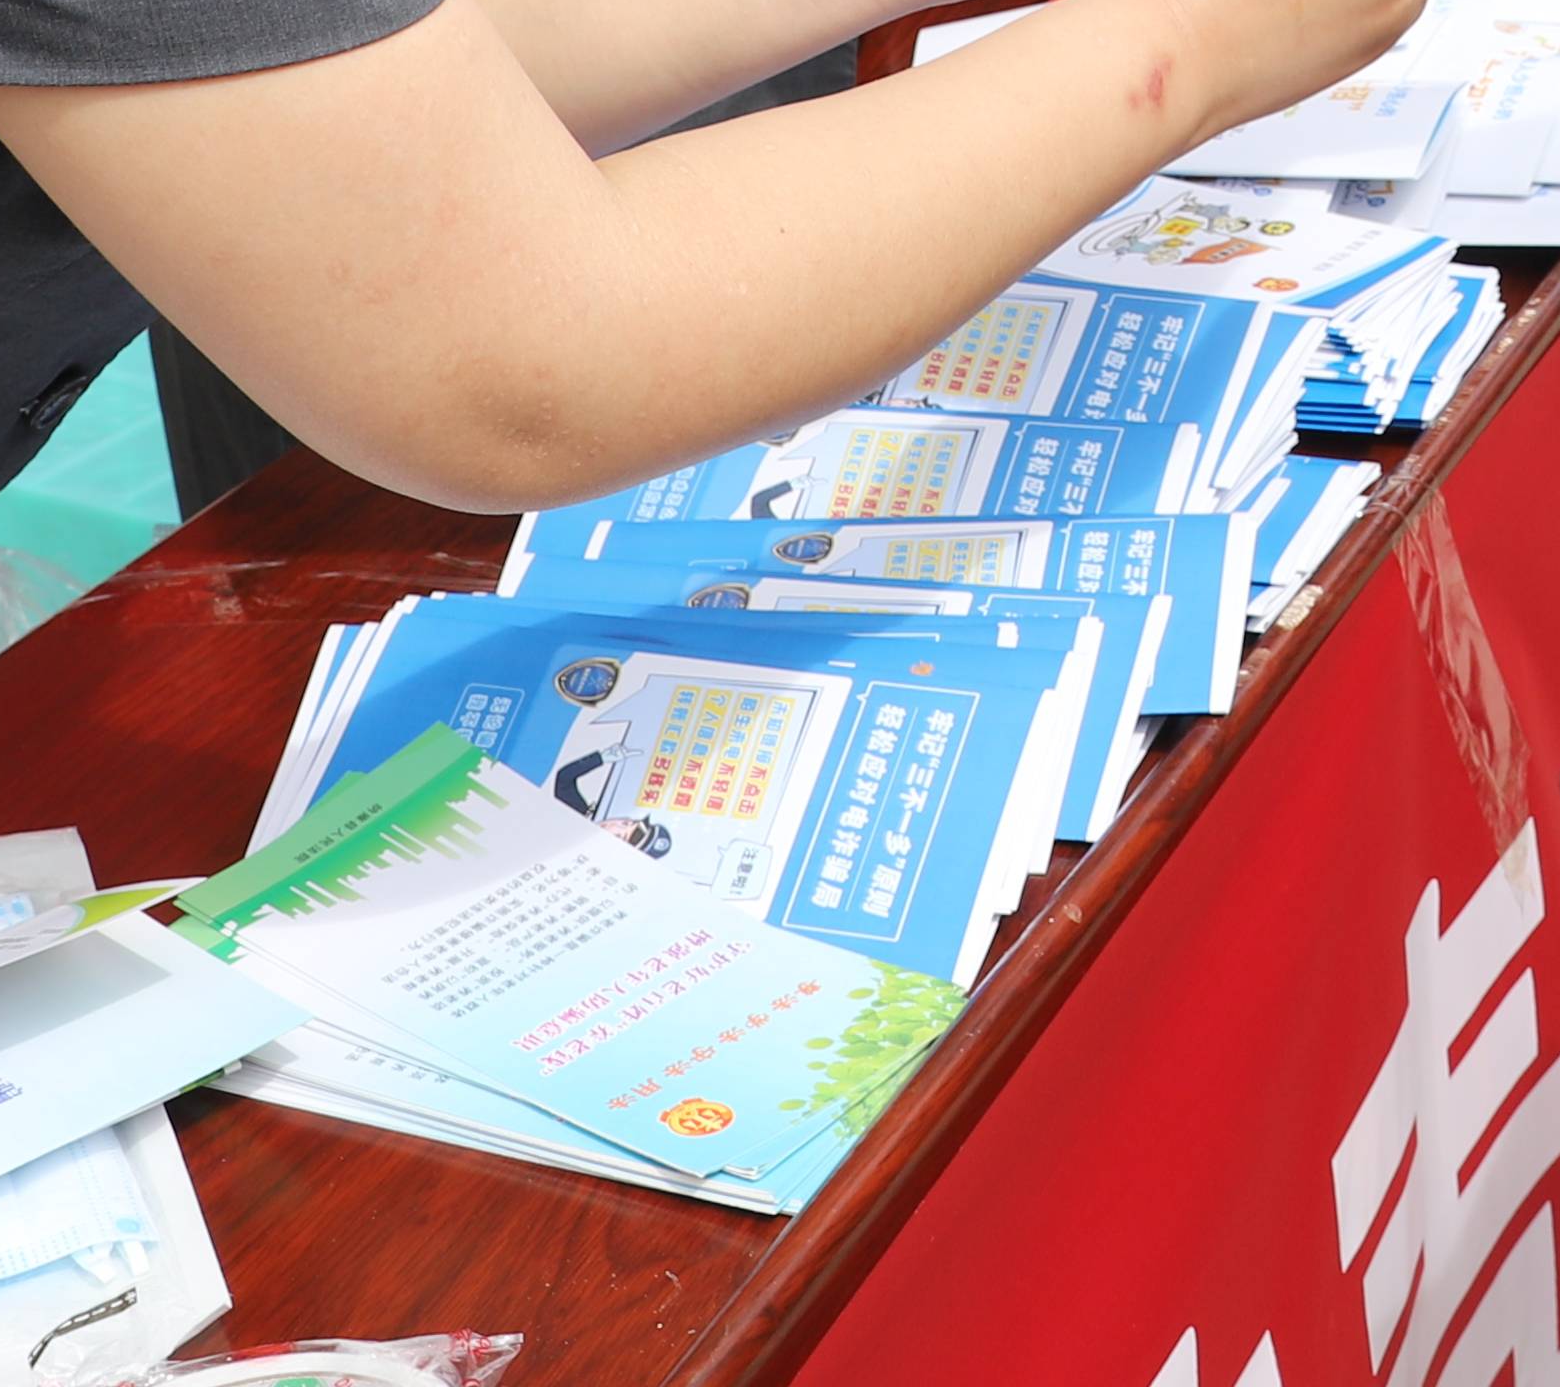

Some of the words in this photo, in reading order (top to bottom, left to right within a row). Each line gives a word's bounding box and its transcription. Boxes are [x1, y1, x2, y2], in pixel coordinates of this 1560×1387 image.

[641, 690, 696, 805] 转账汇款多核实
[673, 693, 730, 809] 个人信息不透露
[707, 696, 760, 812] 陌生来电不轻信
[738, 700, 789, 816] 未知链接不点击
[294, 803, 384, 865] 纳雍县人民法院
[810, 702, 908, 911] 轻松应对电诈骗局
[861, 707, 957, 919] 牢记“三不一多”原则
[510, 928, 715, 1053] 增强老年人防骗意识
[539, 937, 754, 1077] 守护好老百姓“养老钱”
